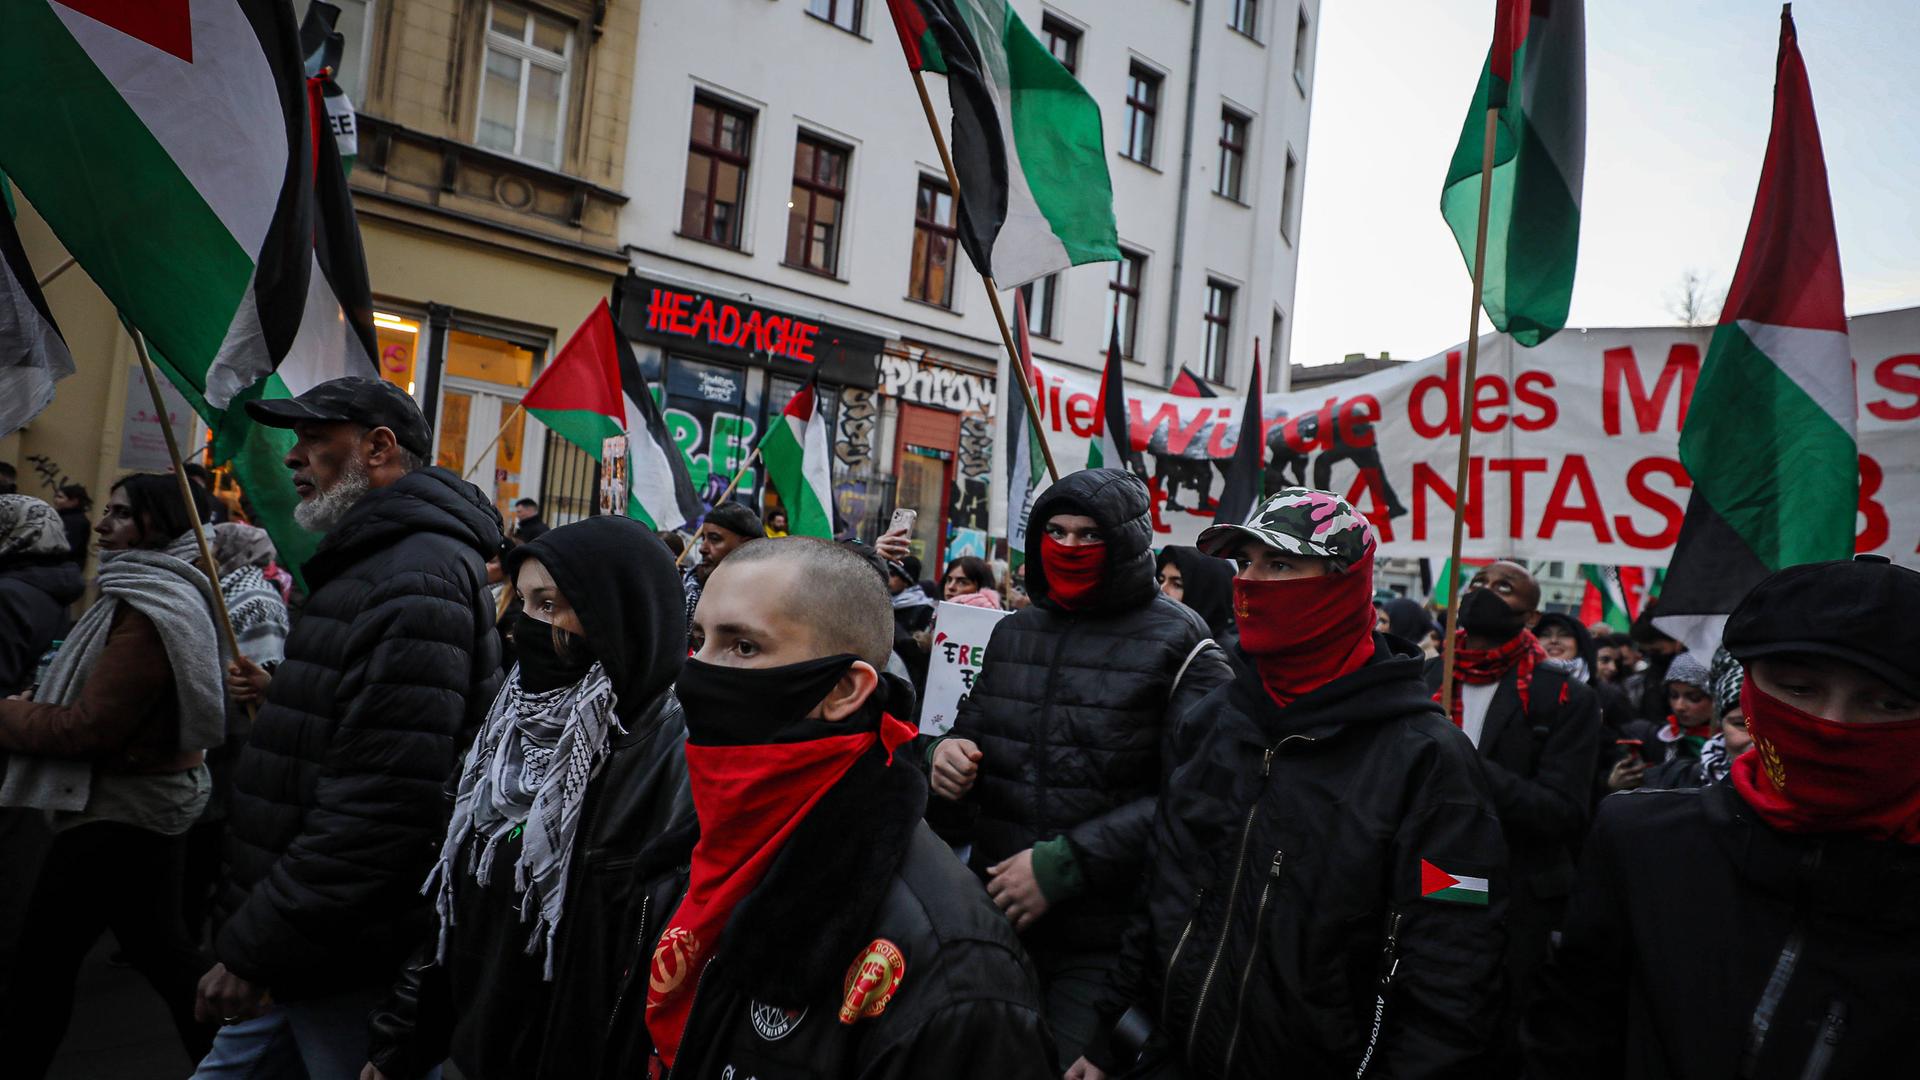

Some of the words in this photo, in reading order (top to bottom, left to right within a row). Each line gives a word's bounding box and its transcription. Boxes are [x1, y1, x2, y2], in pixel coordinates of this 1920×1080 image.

[646, 288, 820, 364] HEADACHE
[1408, 351, 1560, 439] des
[942, 642, 985, 667] FRE
[875, 943, 901, 968] ROTER
[1370, 994, 1385, 1046] AVIATOR
[1356, 1046, 1373, 1080] CREW
